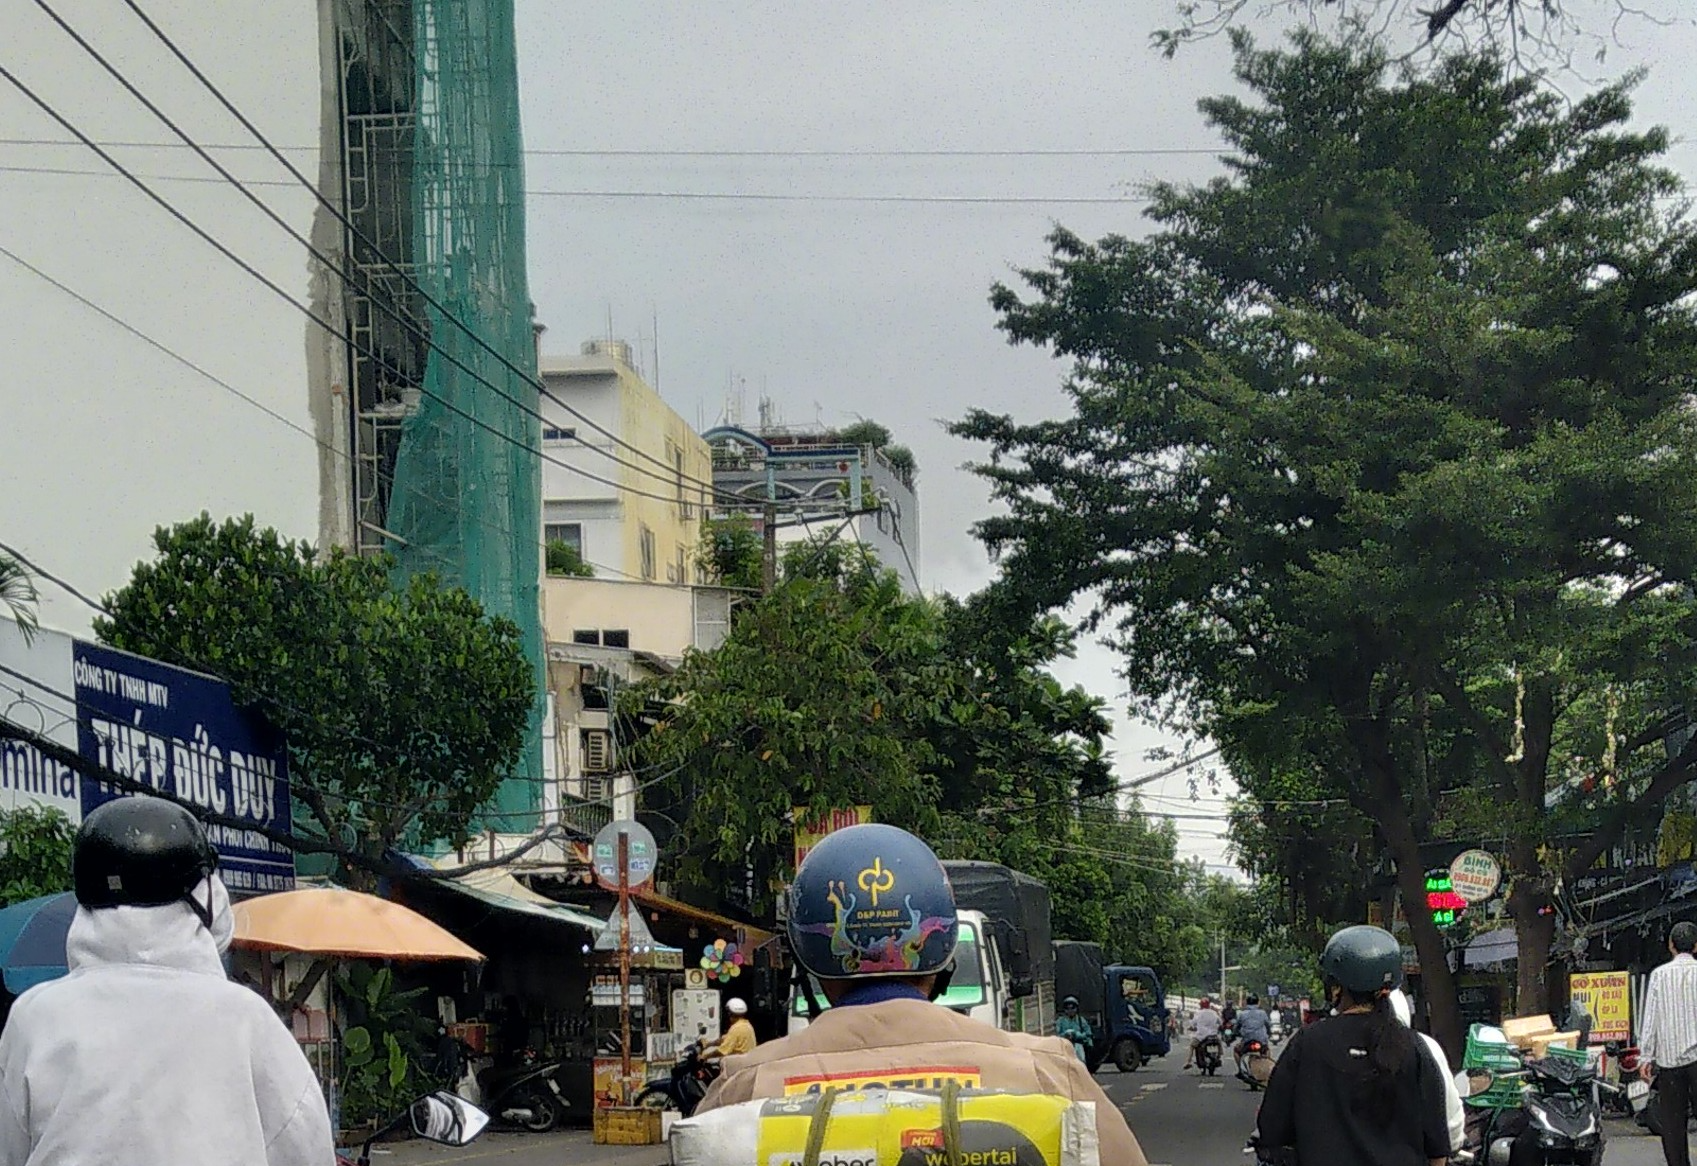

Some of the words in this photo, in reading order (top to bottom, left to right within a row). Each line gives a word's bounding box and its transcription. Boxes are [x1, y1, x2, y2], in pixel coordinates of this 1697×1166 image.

[75, 656, 103, 691] CÔNG
[104, 669, 117, 695] TY
[119, 674, 146, 703] TNHH
[230, 750, 276, 820] DUY
